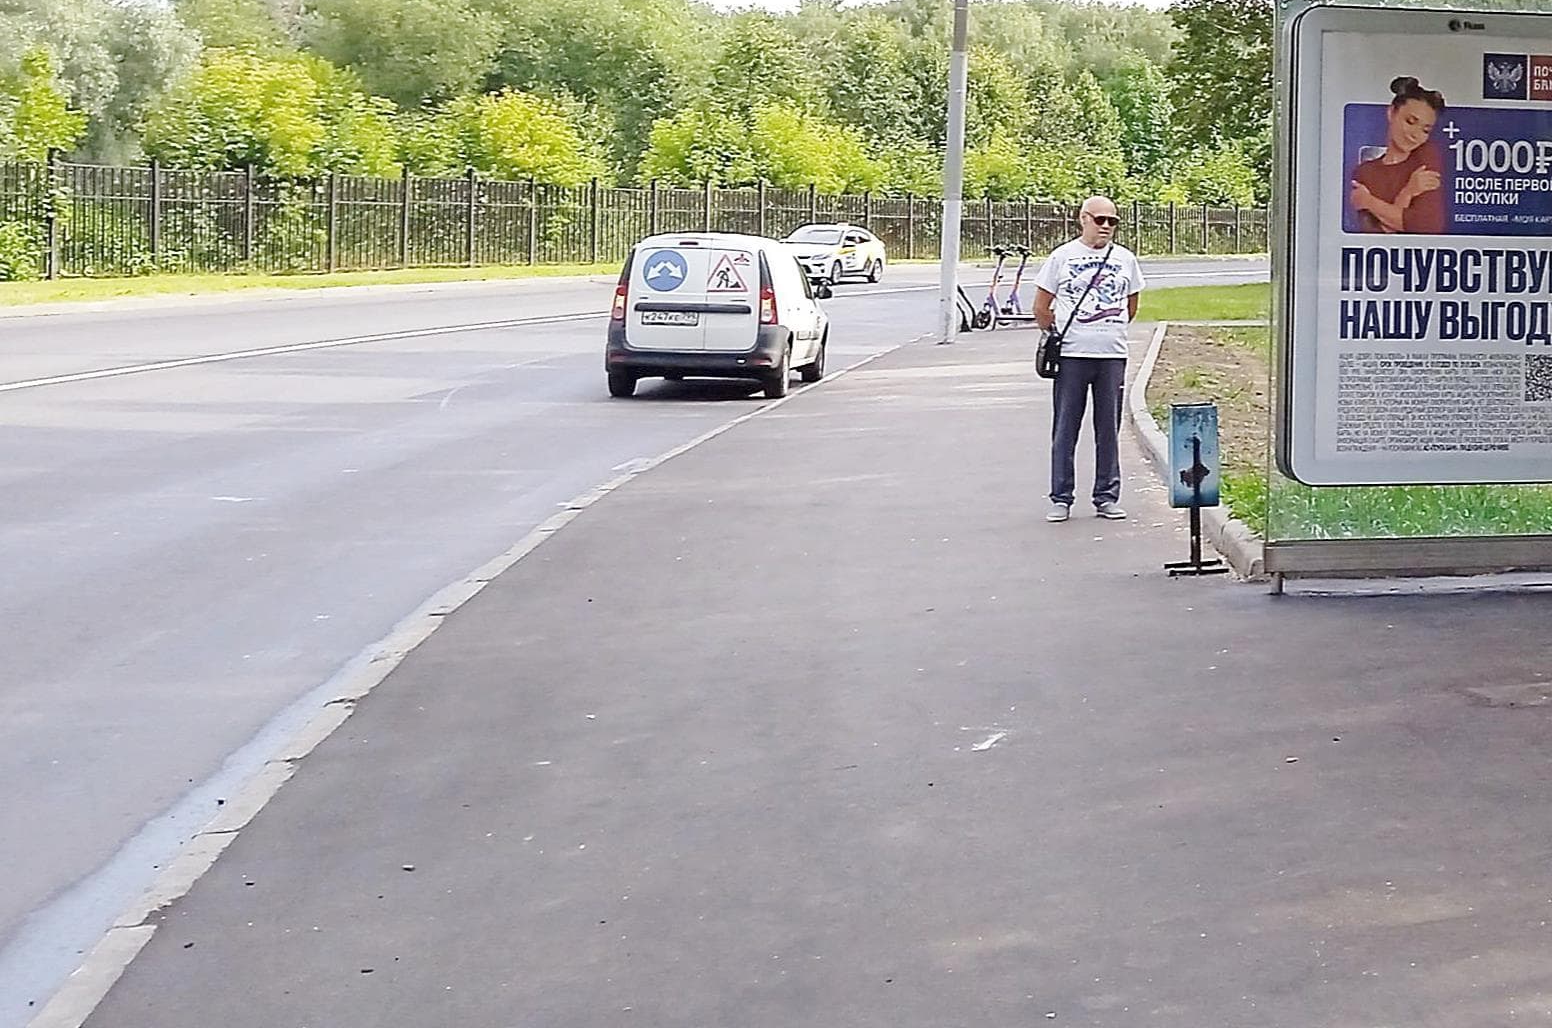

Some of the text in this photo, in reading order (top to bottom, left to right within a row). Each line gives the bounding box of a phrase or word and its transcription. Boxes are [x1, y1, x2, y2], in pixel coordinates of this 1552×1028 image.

[1455, 177, 1503, 190] ПОСЛЕ
[1454, 191, 1519, 205] ПОКУПКИ
[1339, 299, 1434, 340] НАШУ
